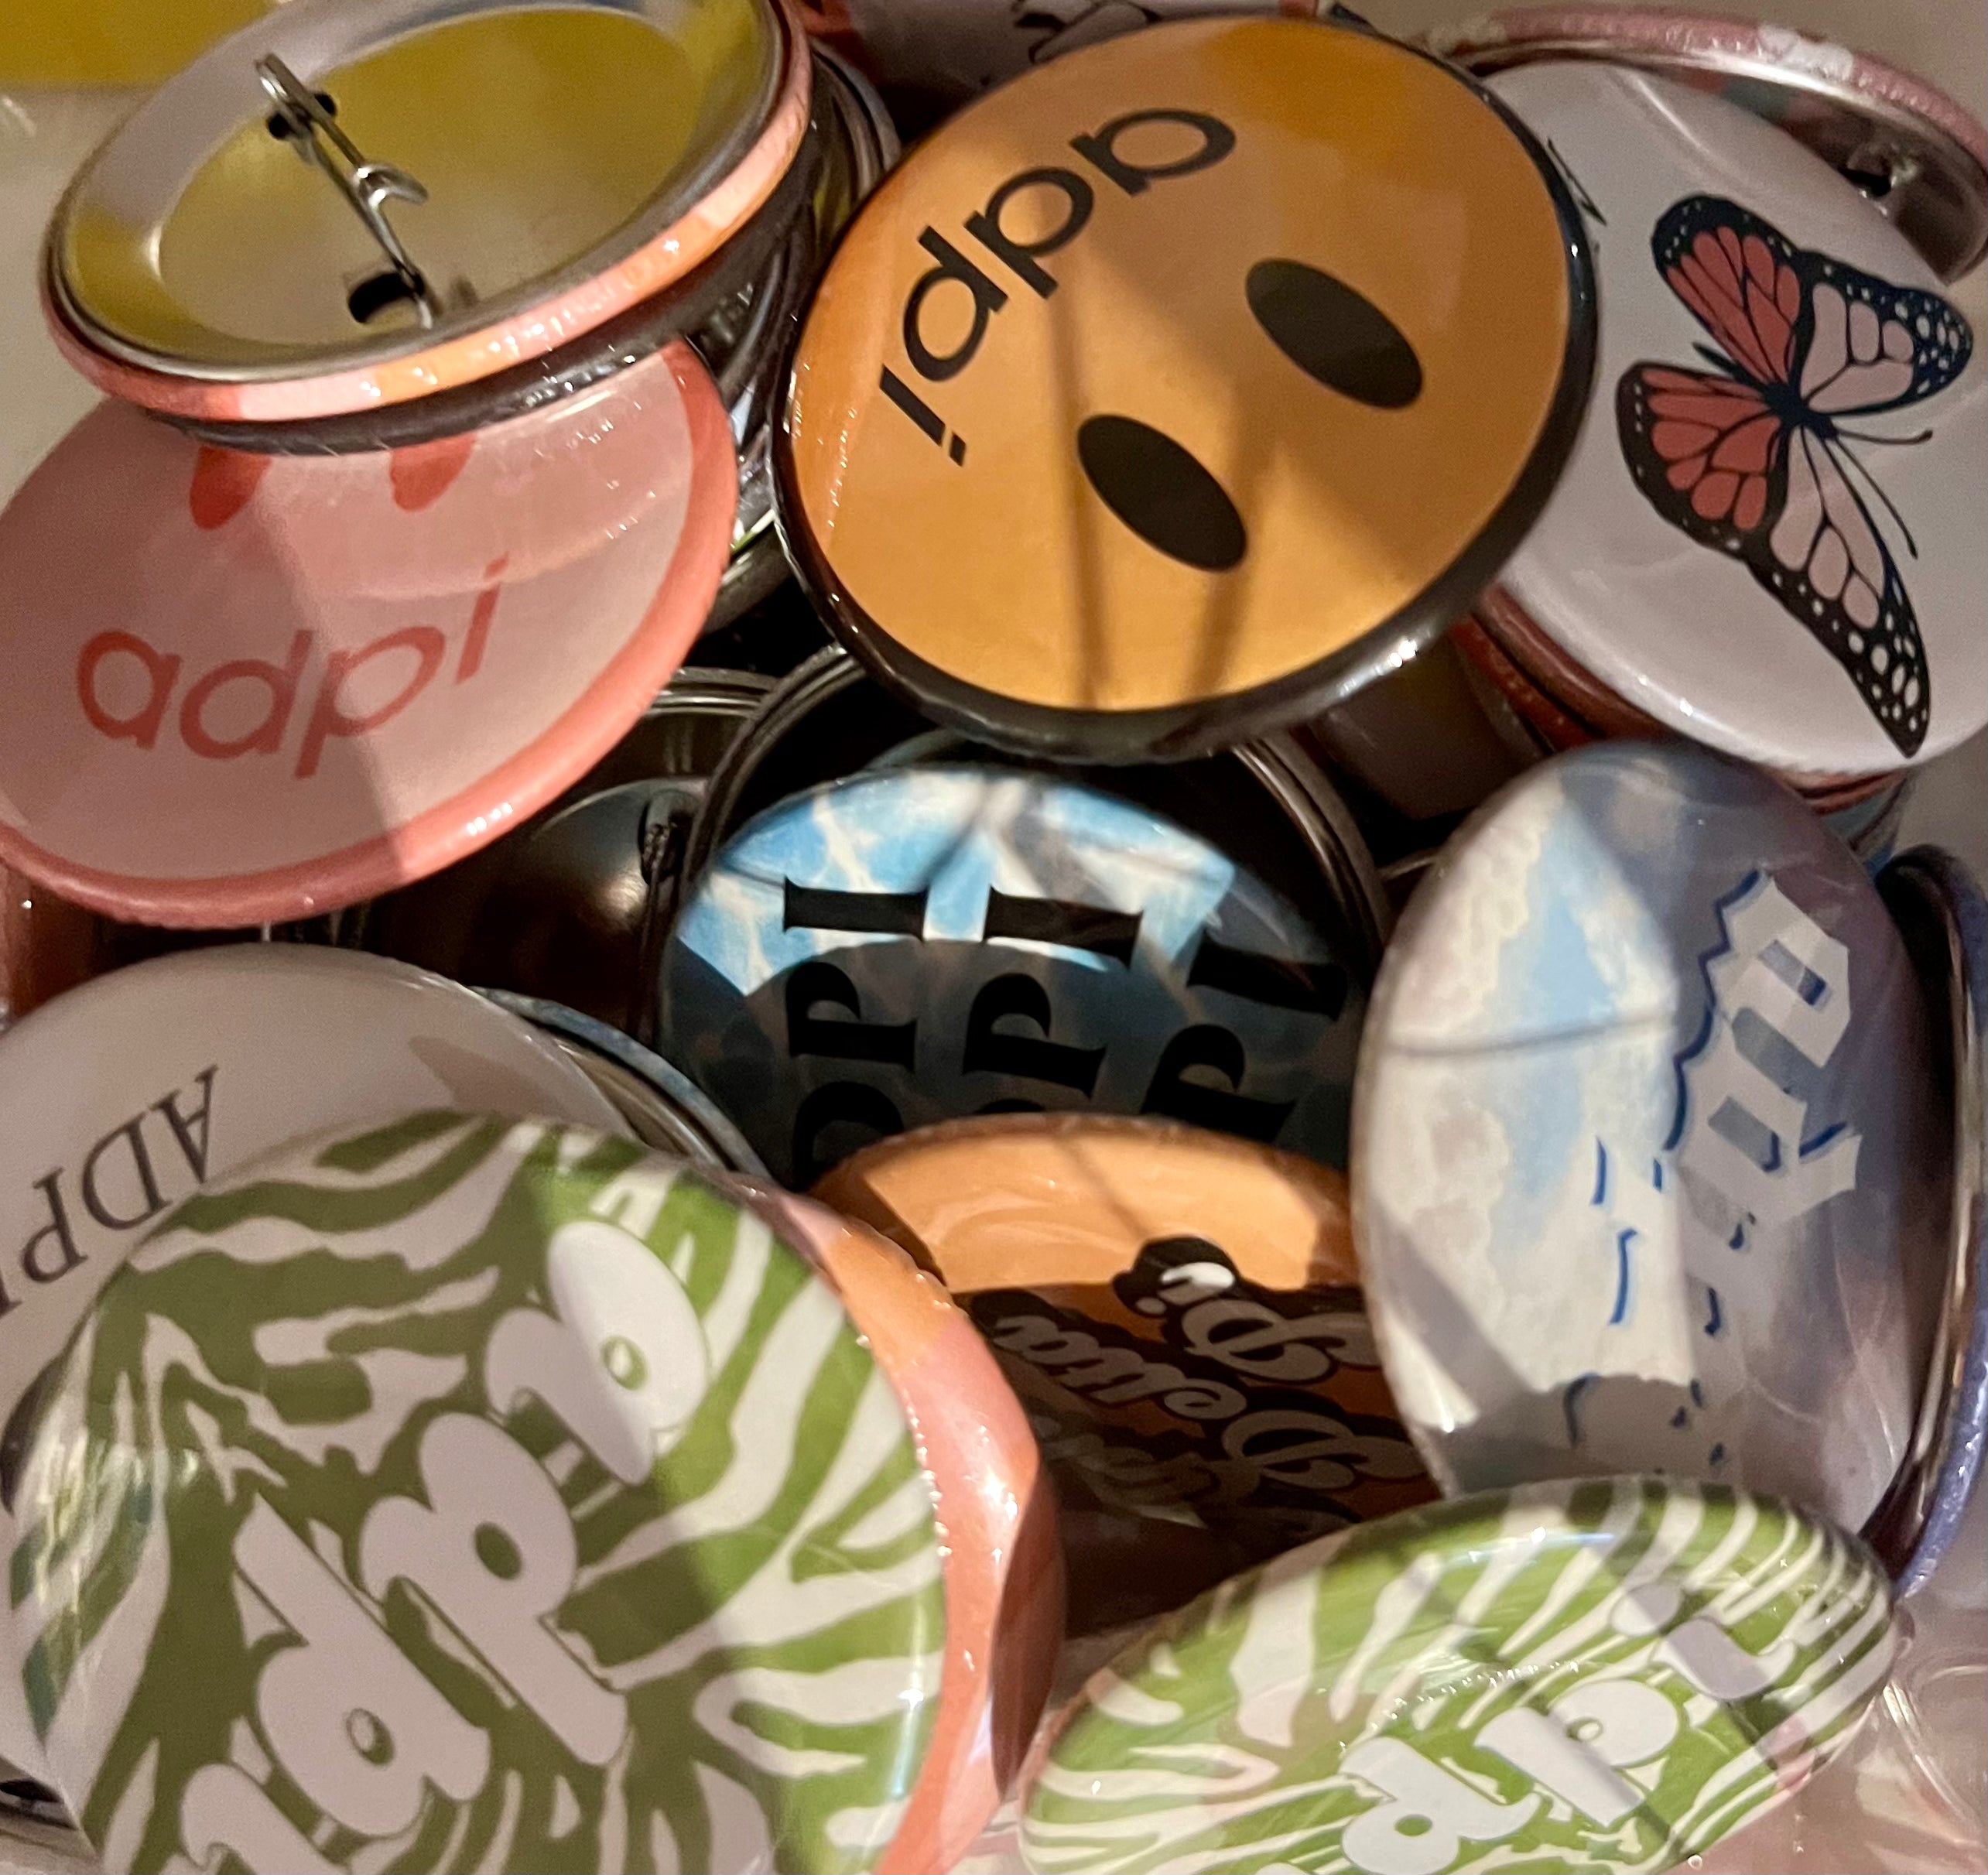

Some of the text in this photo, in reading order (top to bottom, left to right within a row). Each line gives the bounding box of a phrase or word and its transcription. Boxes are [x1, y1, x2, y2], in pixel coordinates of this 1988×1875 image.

[879, 108, 1237, 467] adpi
[78, 553, 510, 779] adpi
[994, 1314, 1431, 1489] Delta
[1255, 1581, 1798, 1875] dpi
